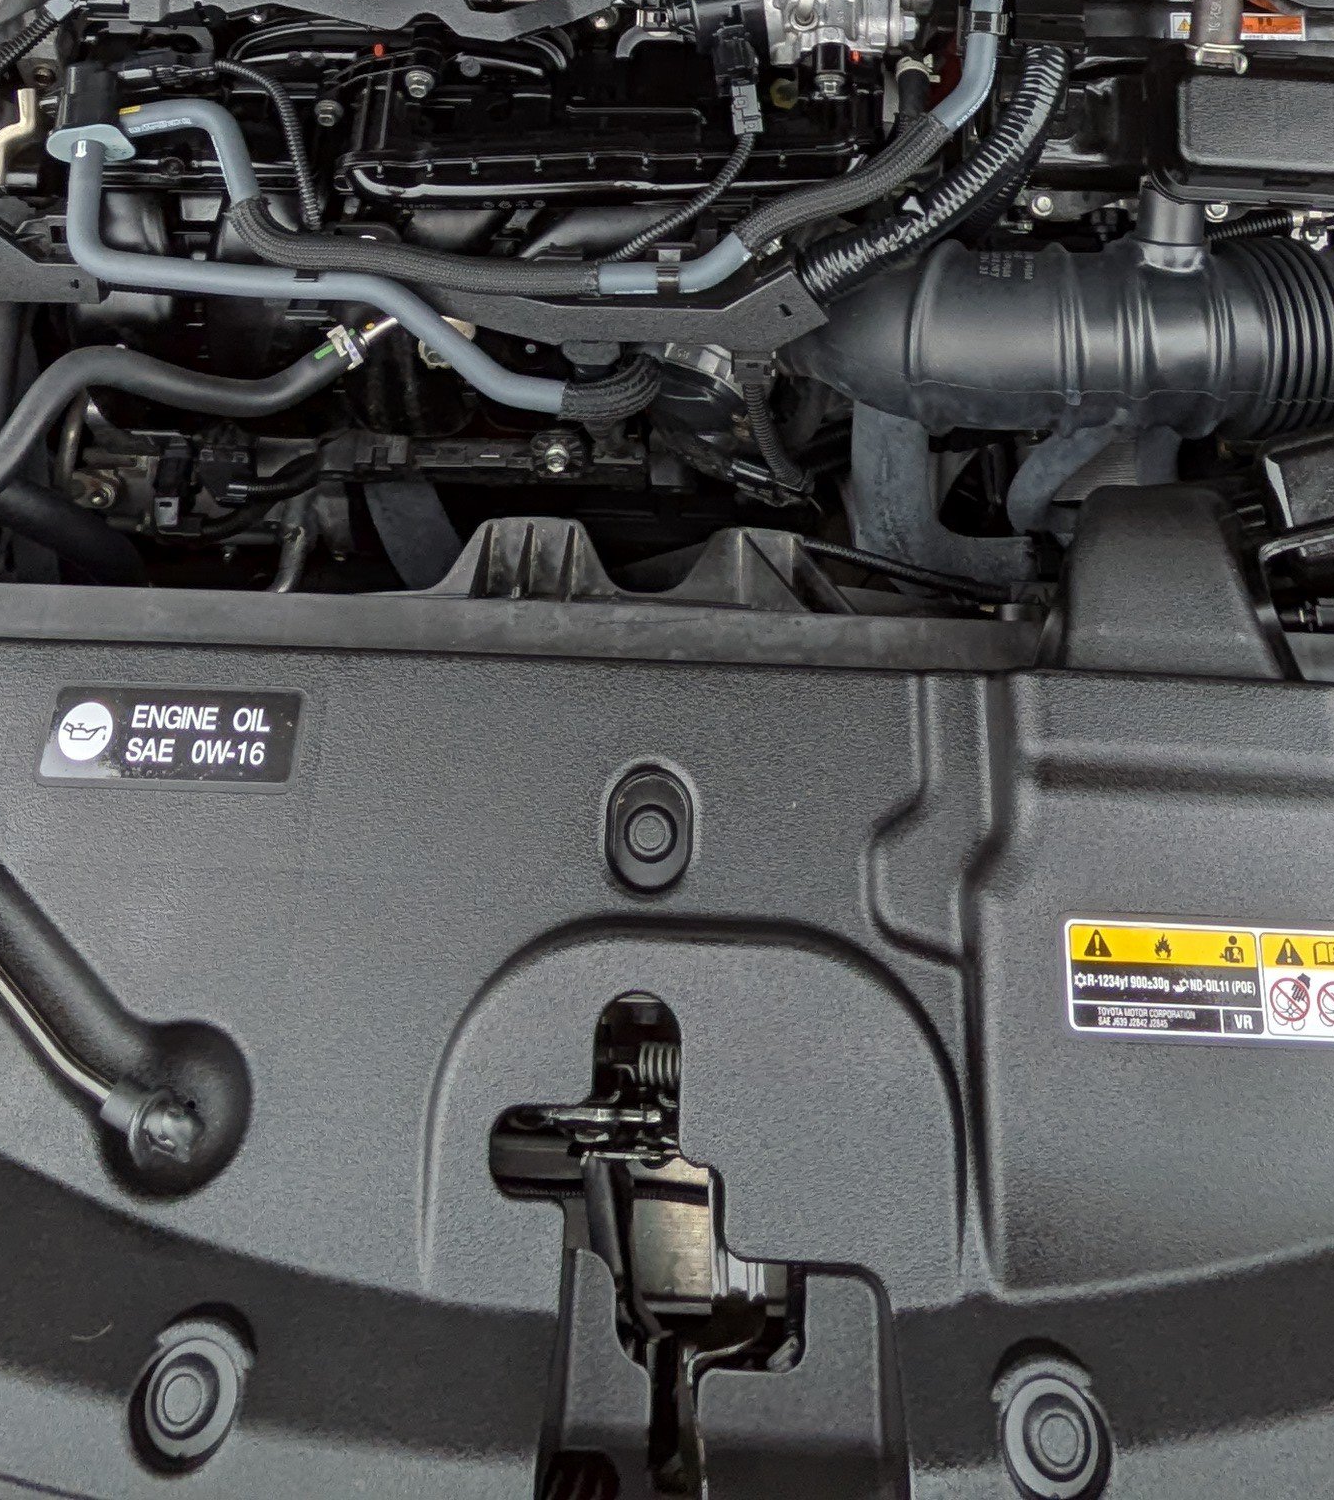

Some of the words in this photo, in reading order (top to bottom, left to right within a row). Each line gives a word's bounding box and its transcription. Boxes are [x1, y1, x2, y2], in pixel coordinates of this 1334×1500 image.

[131, 705, 219, 730] ENGINE
[232, 707, 271, 733] OIL
[125, 738, 175, 762] SAE
[191, 739, 266, 766] 0W-16
[1231, 979, 1256, 996] (POE)
[1097, 1006, 1123, 1018] TOYOTA
[1123, 1007, 1148, 1019] MOTOR
[1149, 1008, 1196, 1021] CORPORATION
[1097, 1017, 1111, 1027] SAE
[1233, 1013, 1254, 1031] VR
